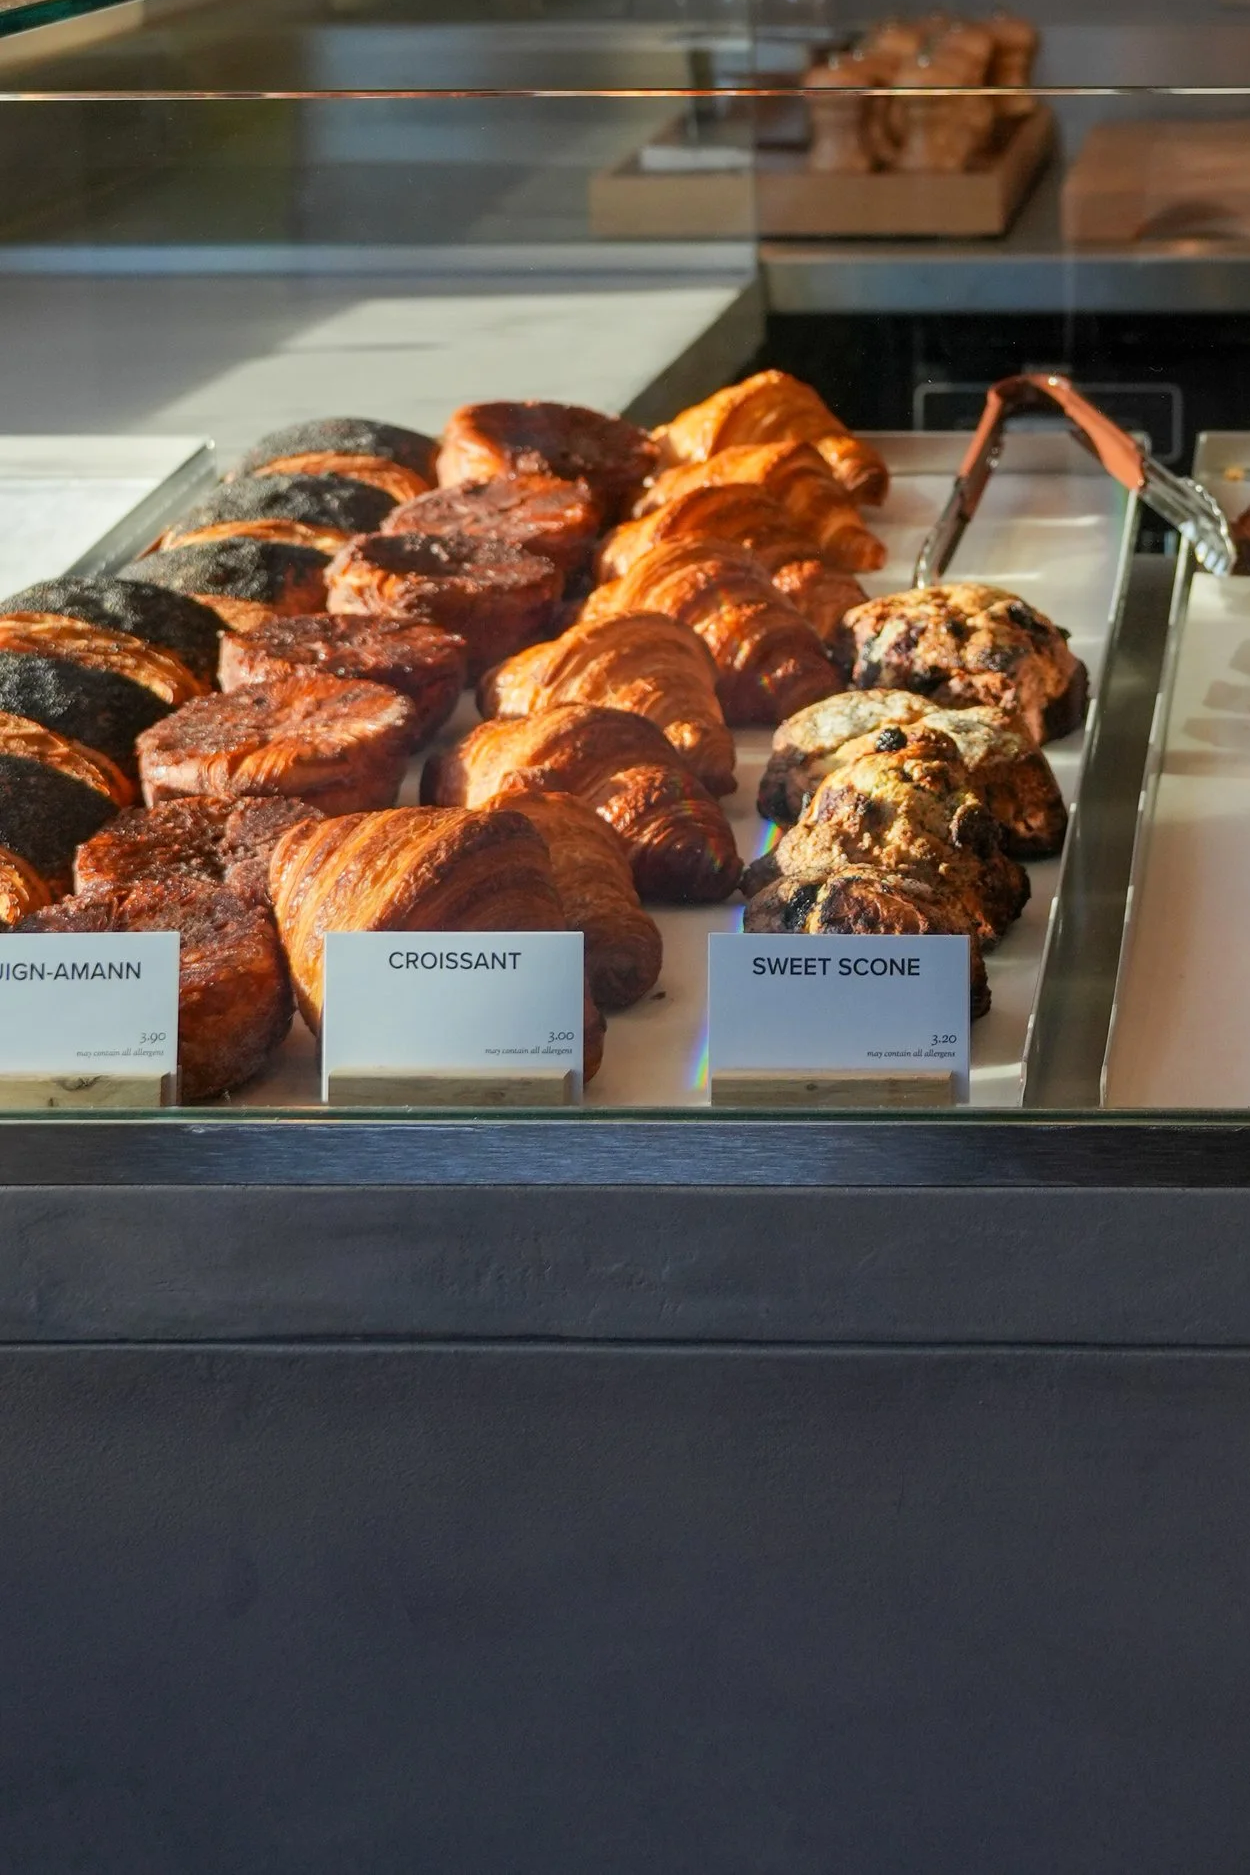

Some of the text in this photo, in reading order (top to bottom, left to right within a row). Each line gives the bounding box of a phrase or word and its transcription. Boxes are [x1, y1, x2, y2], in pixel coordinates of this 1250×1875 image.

[388, 951, 522, 970] CROISSANT
[752, 956, 921, 977] SWEET SCONE
[0, 961, 142, 981] IGN-AMANN
[139, 1031, 167, 1044] 3.90
[547, 1031, 575, 1043] 3.00
[931, 1034, 958, 1046] 3.20
[76, 1047, 164, 1059] may contain all allergens
[485, 1045, 573, 1056] may contain all allergens
[867, 1048, 956, 1060] may contain all allergens
